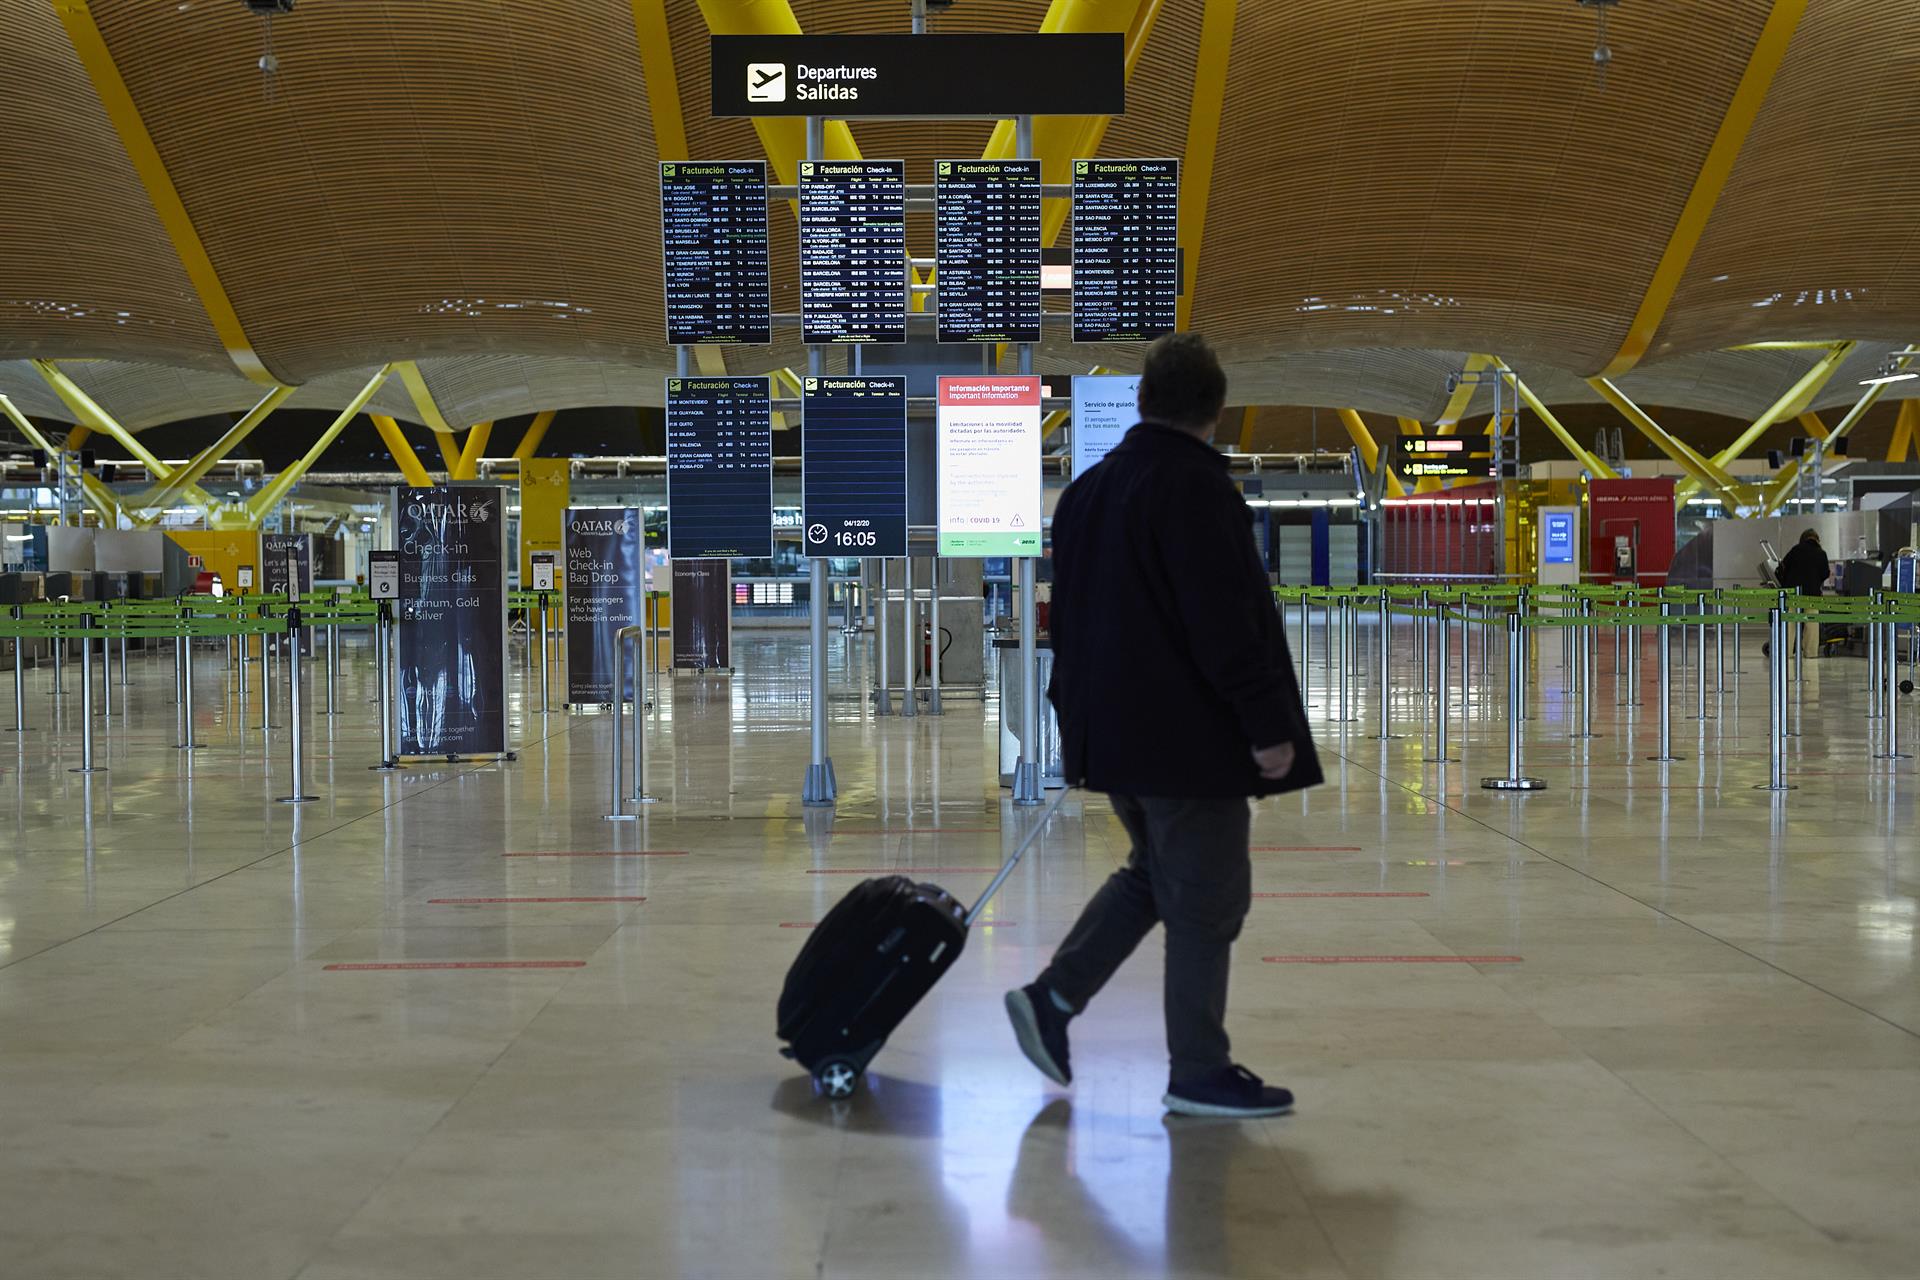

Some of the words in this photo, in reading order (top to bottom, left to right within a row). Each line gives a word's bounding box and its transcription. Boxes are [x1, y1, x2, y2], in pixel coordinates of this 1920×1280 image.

[797, 65, 877, 82] Departures
[797, 84, 858, 100] Salidas
[408, 503, 468, 519] QATAR
[572, 521, 612, 533] QATAR
[834, 532, 876, 546] 16:05
[404, 541, 468, 554] Check-in
[570, 548, 591, 558] Web
[570, 560, 613, 570] Check-in
[404, 573, 448, 583] Business
[452, 573, 476, 583] Class
[570, 573, 588, 584] Bag
[592, 573, 618, 583] Drop
[405, 598, 452, 608] Platinum,
[456, 597, 479, 607] Gold
[584, 597, 623, 605] passengers
[405, 610, 413, 620] &
[415, 611, 443, 620] Silver
